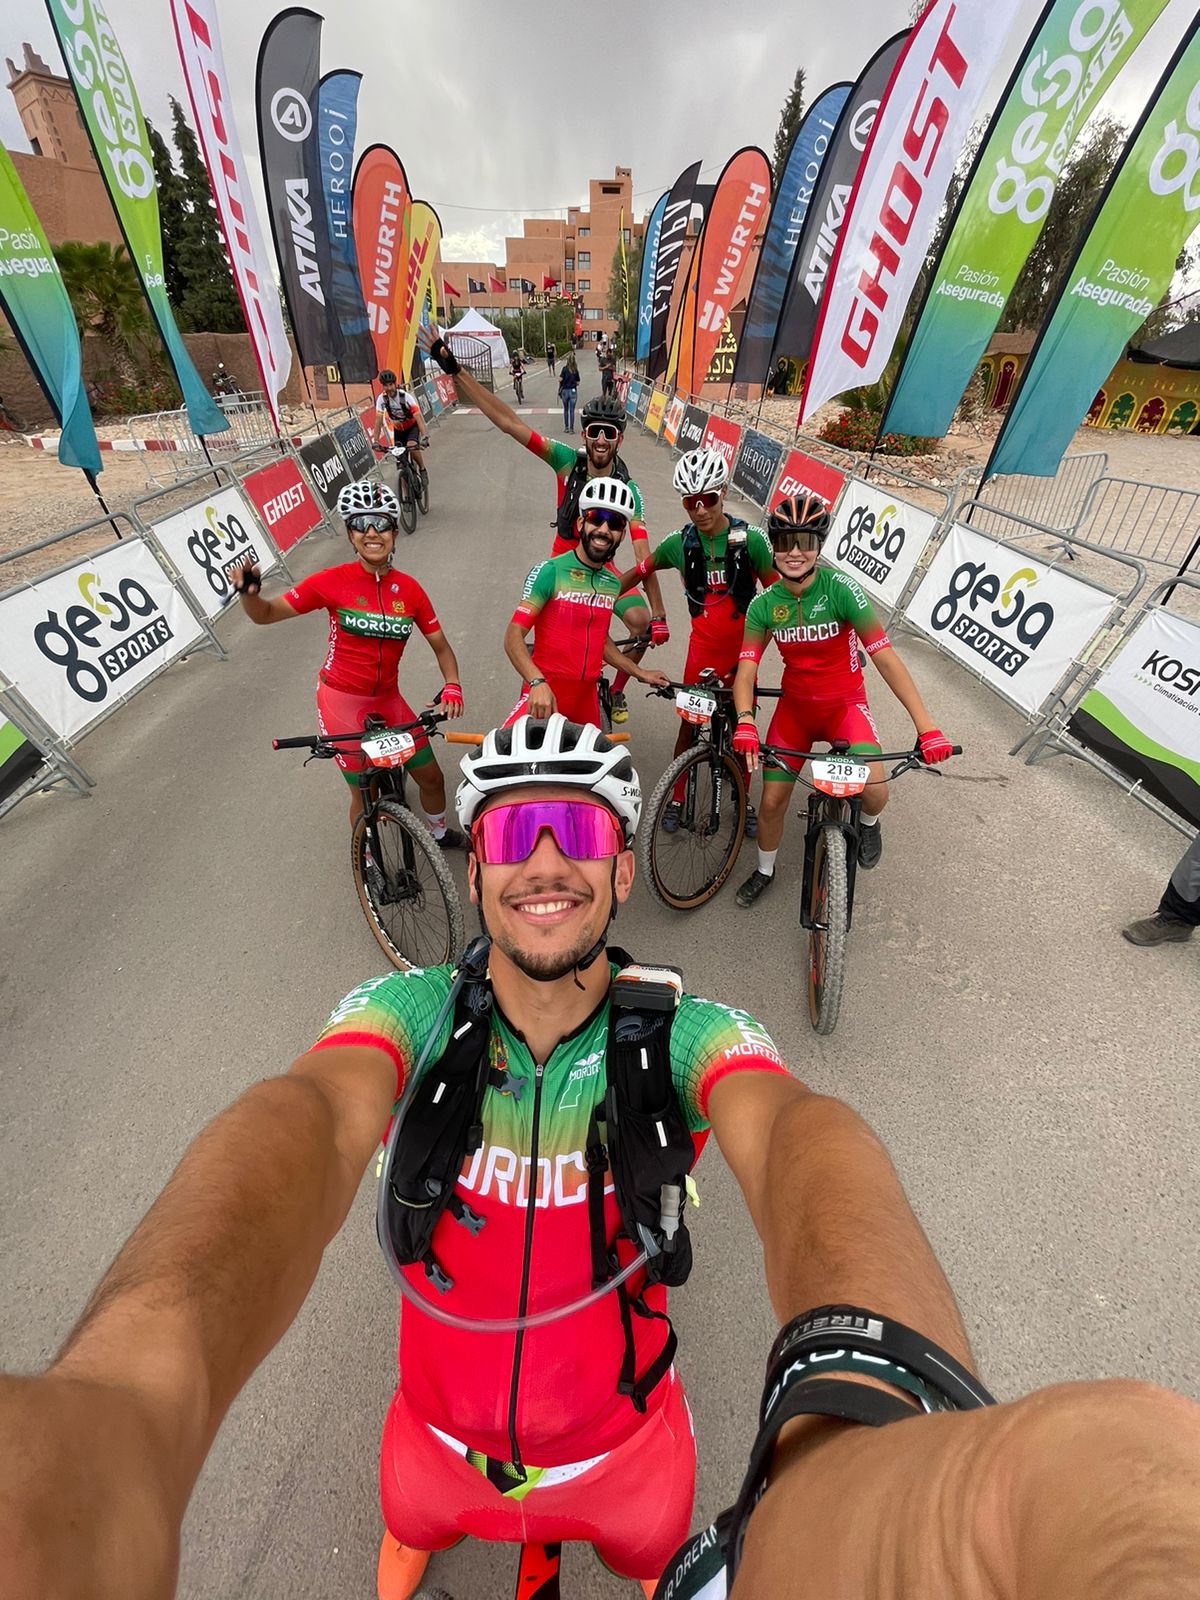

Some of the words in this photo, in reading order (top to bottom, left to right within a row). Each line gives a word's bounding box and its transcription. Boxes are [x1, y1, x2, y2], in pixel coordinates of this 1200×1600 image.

[841, 3, 968, 369] GHOST
[284, 178, 326, 306] ATIKA
[373, 180, 402, 297] WÜRTH
[713, 182, 766, 297] WÜRTH
[804, 184, 853, 305] ATIKA
[936, 279, 1005, 309] Asegurada
[955, 264, 999, 288] Pasión
[1070, 276, 1153, 316] Asegurada
[1097, 258, 1150, 291] Pasión
[322, 454, 345, 483] ATIKA
[262, 482, 306, 526] GHOST
[836, 504, 906, 563] gesa
[849, 547, 889, 584] SPORTS
[832, 572, 868, 610] MOROCCO
[930, 561, 1054, 651] gesa
[34, 572, 159, 703] gesa
[104, 619, 170, 676] SPORTS
[953, 614, 1026, 673] SPORTS
[688, 696, 701, 708] 54
[376, 736, 400, 750] 219
[827, 763, 853, 776] 218
